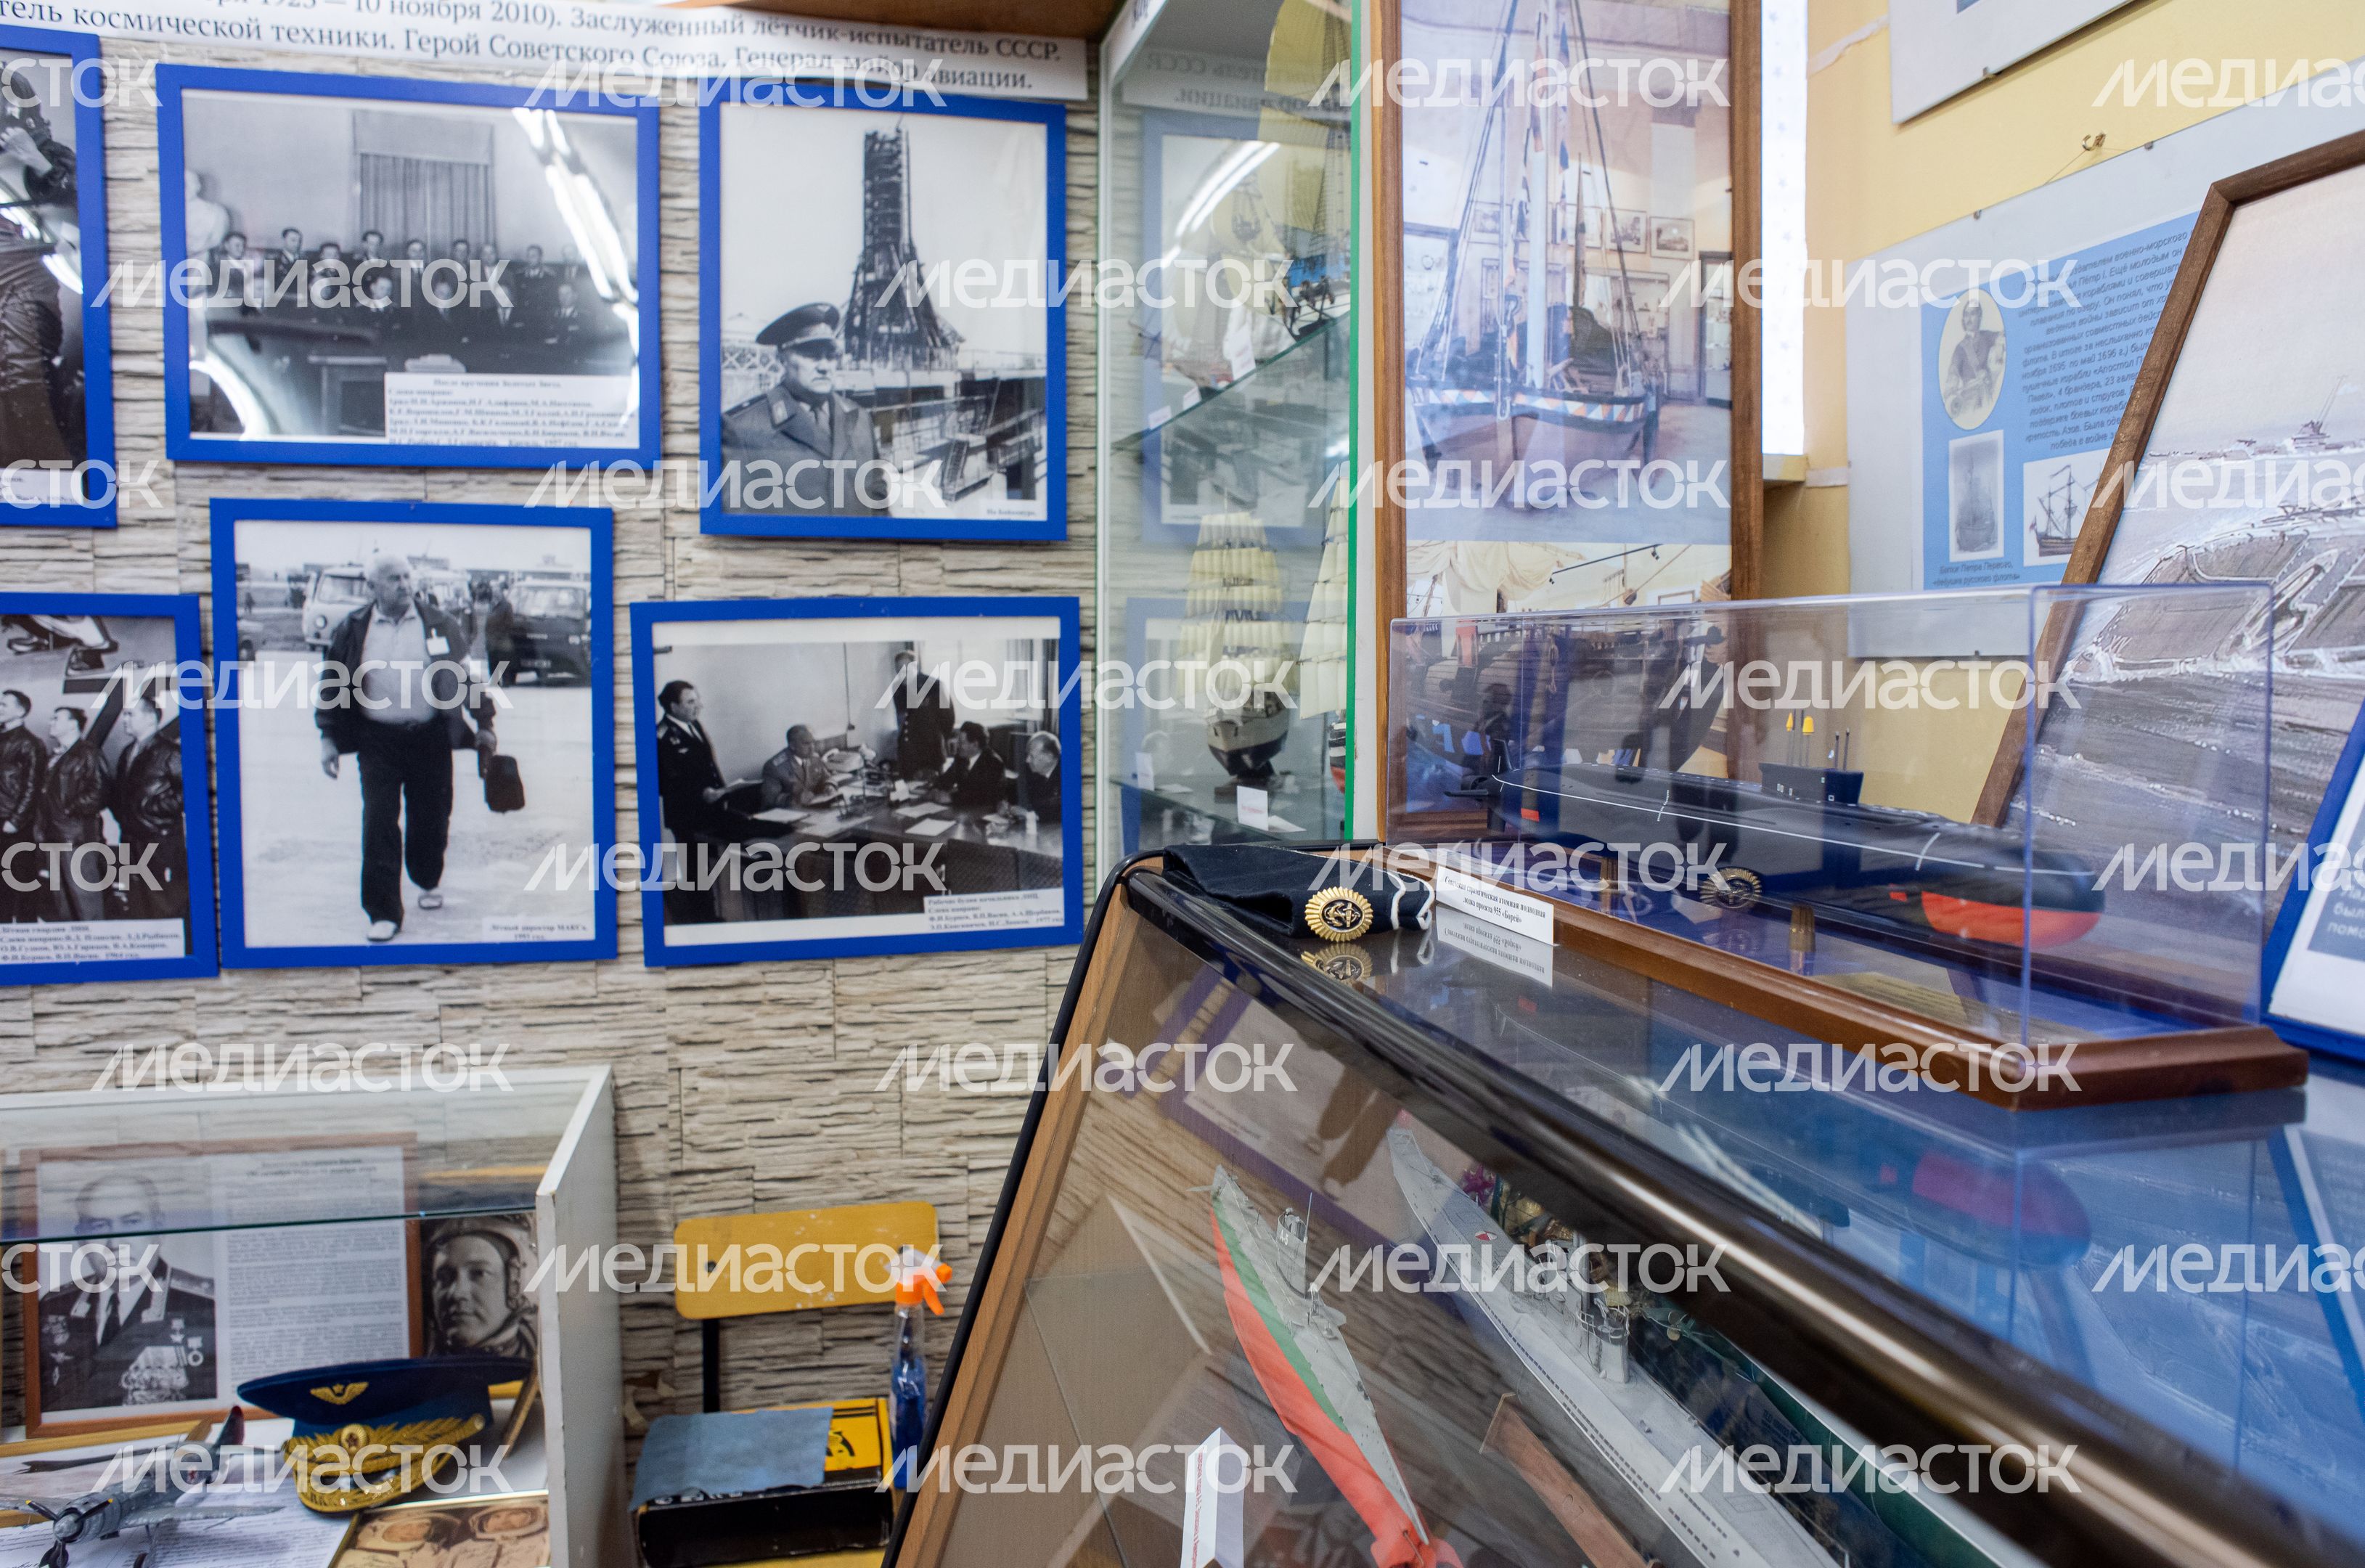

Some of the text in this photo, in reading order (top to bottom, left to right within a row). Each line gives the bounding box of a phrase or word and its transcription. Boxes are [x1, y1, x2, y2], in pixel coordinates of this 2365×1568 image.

[389, 0, 481, 24] ноября
[491, 1, 561, 30] 2010).
[570, 7, 743, 36] Заслуженный
[753, 15, 989, 55] лётчик-испытатель
[995, 37, 1060, 62] СССР.
[73, 8, 261, 41] космической
[271, 23, 395, 49] техники.
[405, 28, 480, 60] Герой
[489, 33, 634, 64] Советского
[642, 45, 727, 70] Союза,
[925, 66, 1032, 91] авиации.
[2066, 232, 2188, 277] оздателем военно-морского
[2109, 264, 2128, 277] Ещё
[2130, 252, 2169, 270] молодым
[2172, 248, 2182, 258] он
[2117, 288, 2143, 302] понял,
[2147, 282, 2163, 292] что
[2141, 298, 2154, 308] от
[2106, 376, 2115, 386] 23
